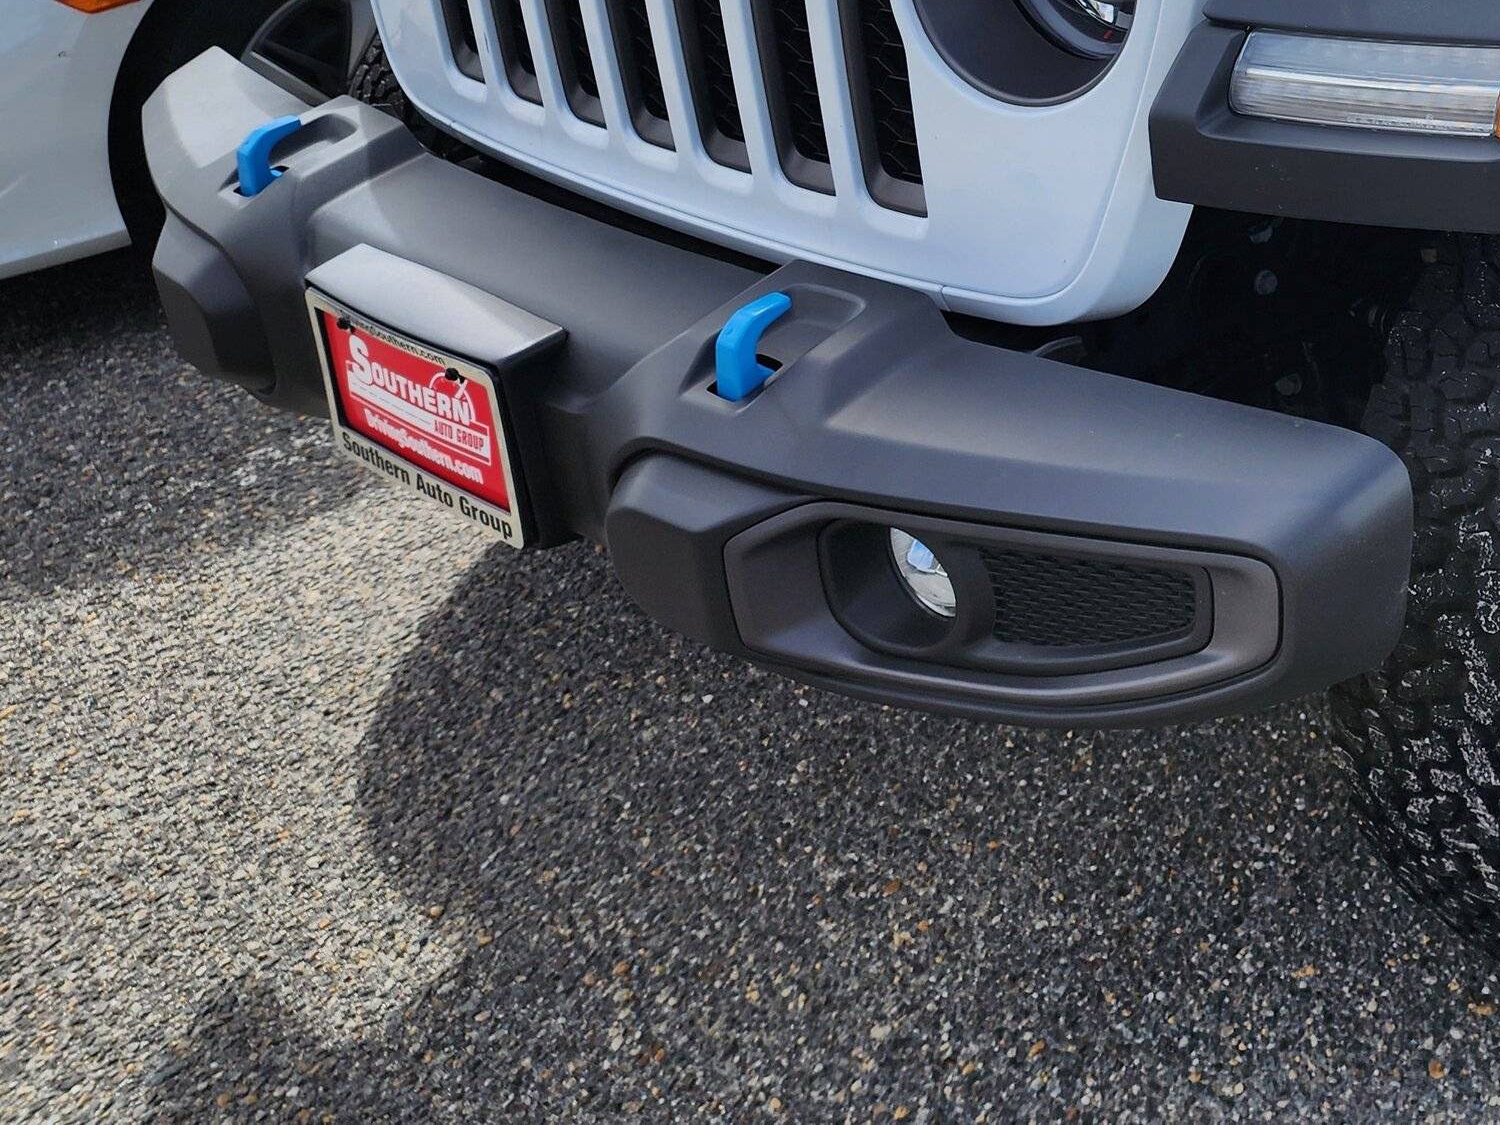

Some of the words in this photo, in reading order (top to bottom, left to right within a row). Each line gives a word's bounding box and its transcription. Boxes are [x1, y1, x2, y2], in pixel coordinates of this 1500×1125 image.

[348, 334, 471, 425] SOUTHERN
[434, 420, 453, 439] AUTO
[456, 428, 484, 450] GROUP
[342, 431, 410, 485] Southern
[416, 474, 453, 508] Auto
[459, 496, 512, 539] Group
